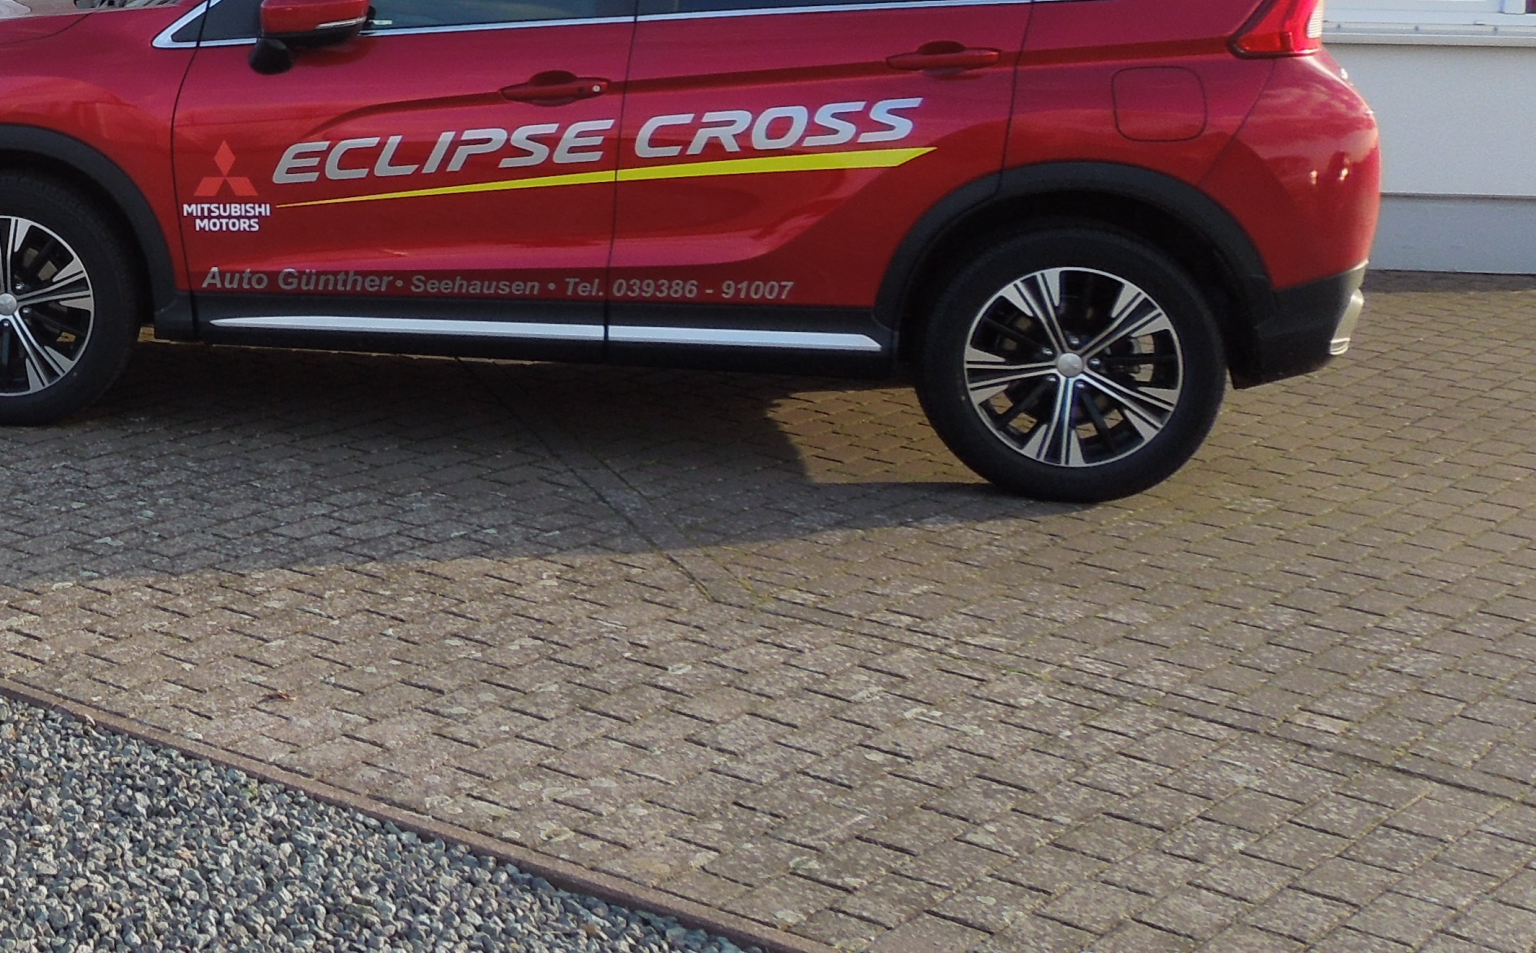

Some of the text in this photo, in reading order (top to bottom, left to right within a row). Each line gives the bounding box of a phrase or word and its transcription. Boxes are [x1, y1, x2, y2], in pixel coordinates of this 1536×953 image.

[272, 97, 924, 185] ECLIPSE CROSS
[182, 203, 271, 217] MITSUBISHI
[195, 218, 260, 232] MOTORS
[201, 266, 268, 289] Auto
[278, 268, 393, 292] Günther
[411, 275, 540, 295] Seehausen
[565, 278, 604, 297] Tel.
[612, 278, 699, 299] 039386
[721, 280, 794, 300] 91007
